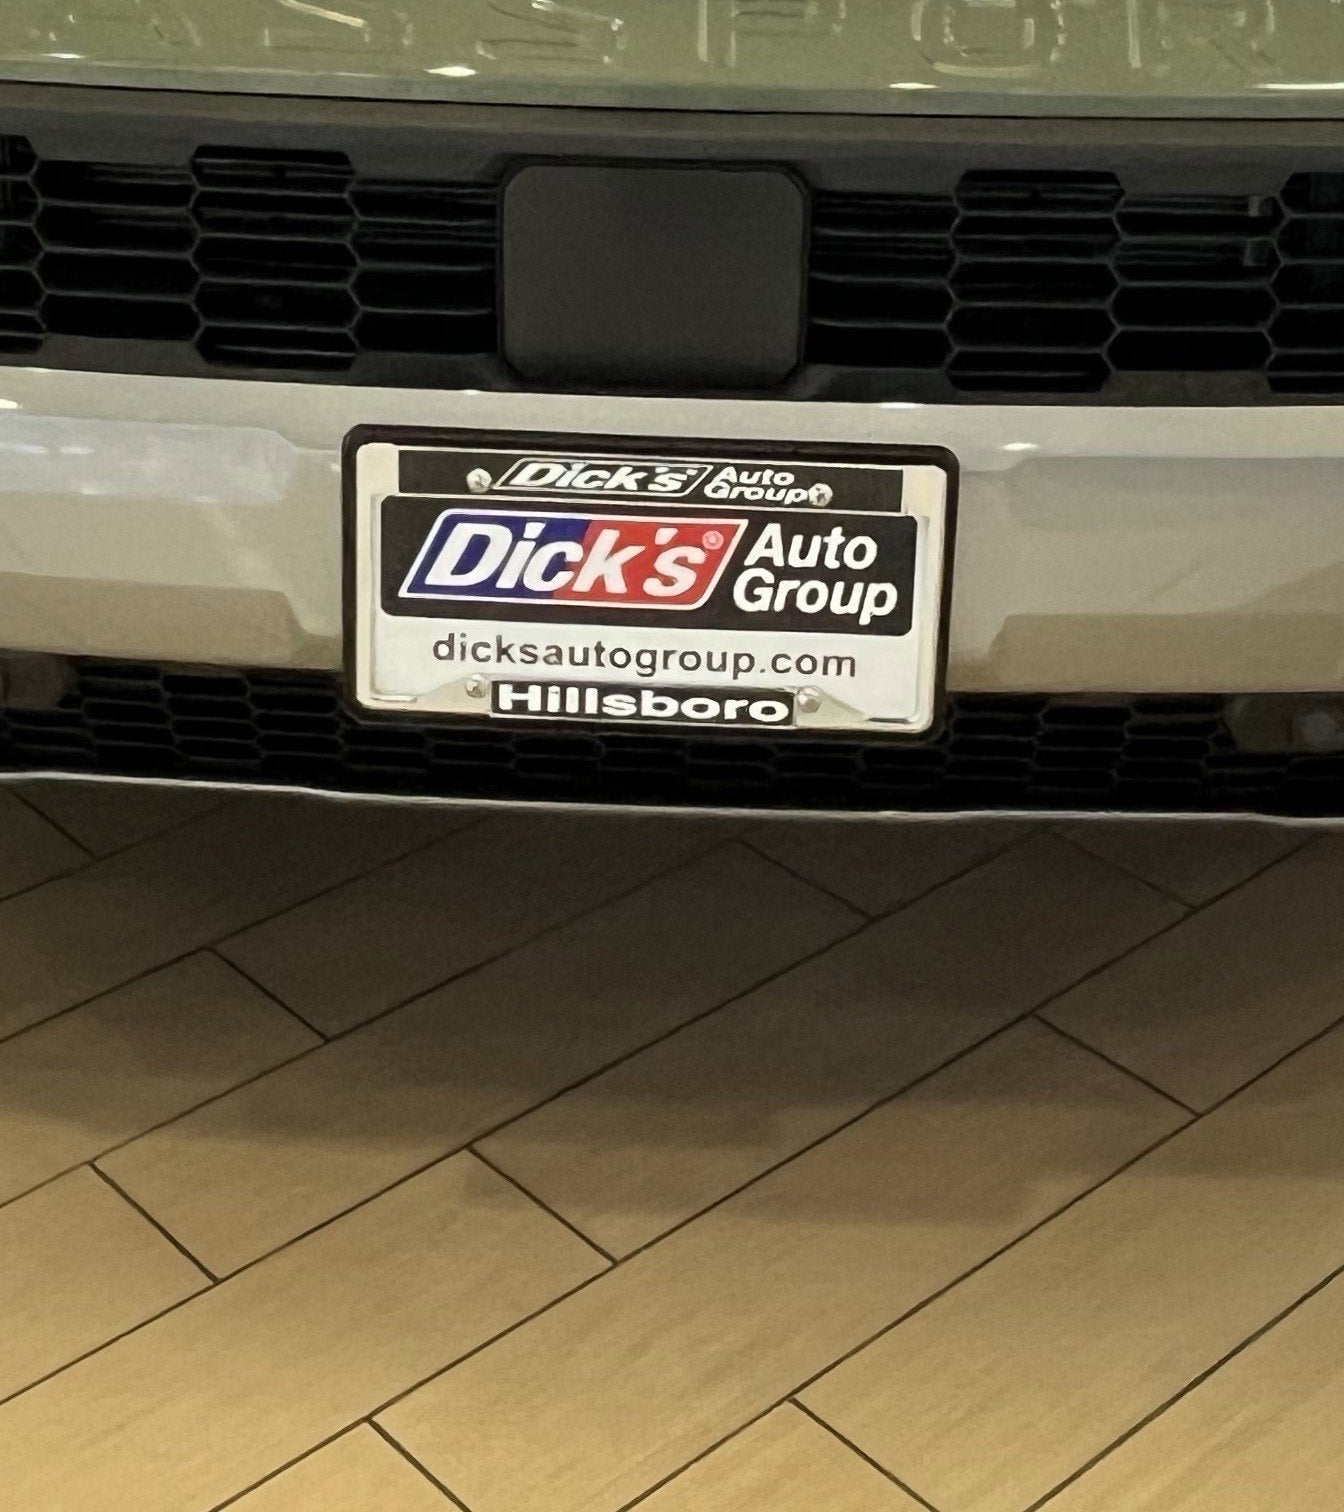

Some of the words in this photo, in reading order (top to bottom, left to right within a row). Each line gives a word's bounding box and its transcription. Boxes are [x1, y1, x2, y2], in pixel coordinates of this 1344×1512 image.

[507, 461, 692, 493] Dick's
[703, 483, 810, 506] Group
[713, 465, 796, 487] Auto
[423, 521, 709, 597] Dick's
[743, 522, 878, 570] Auto
[733, 568, 899, 626] Group
[432, 632, 857, 680] dicksautogroup.com
[496, 684, 791, 724] Hillsboro
